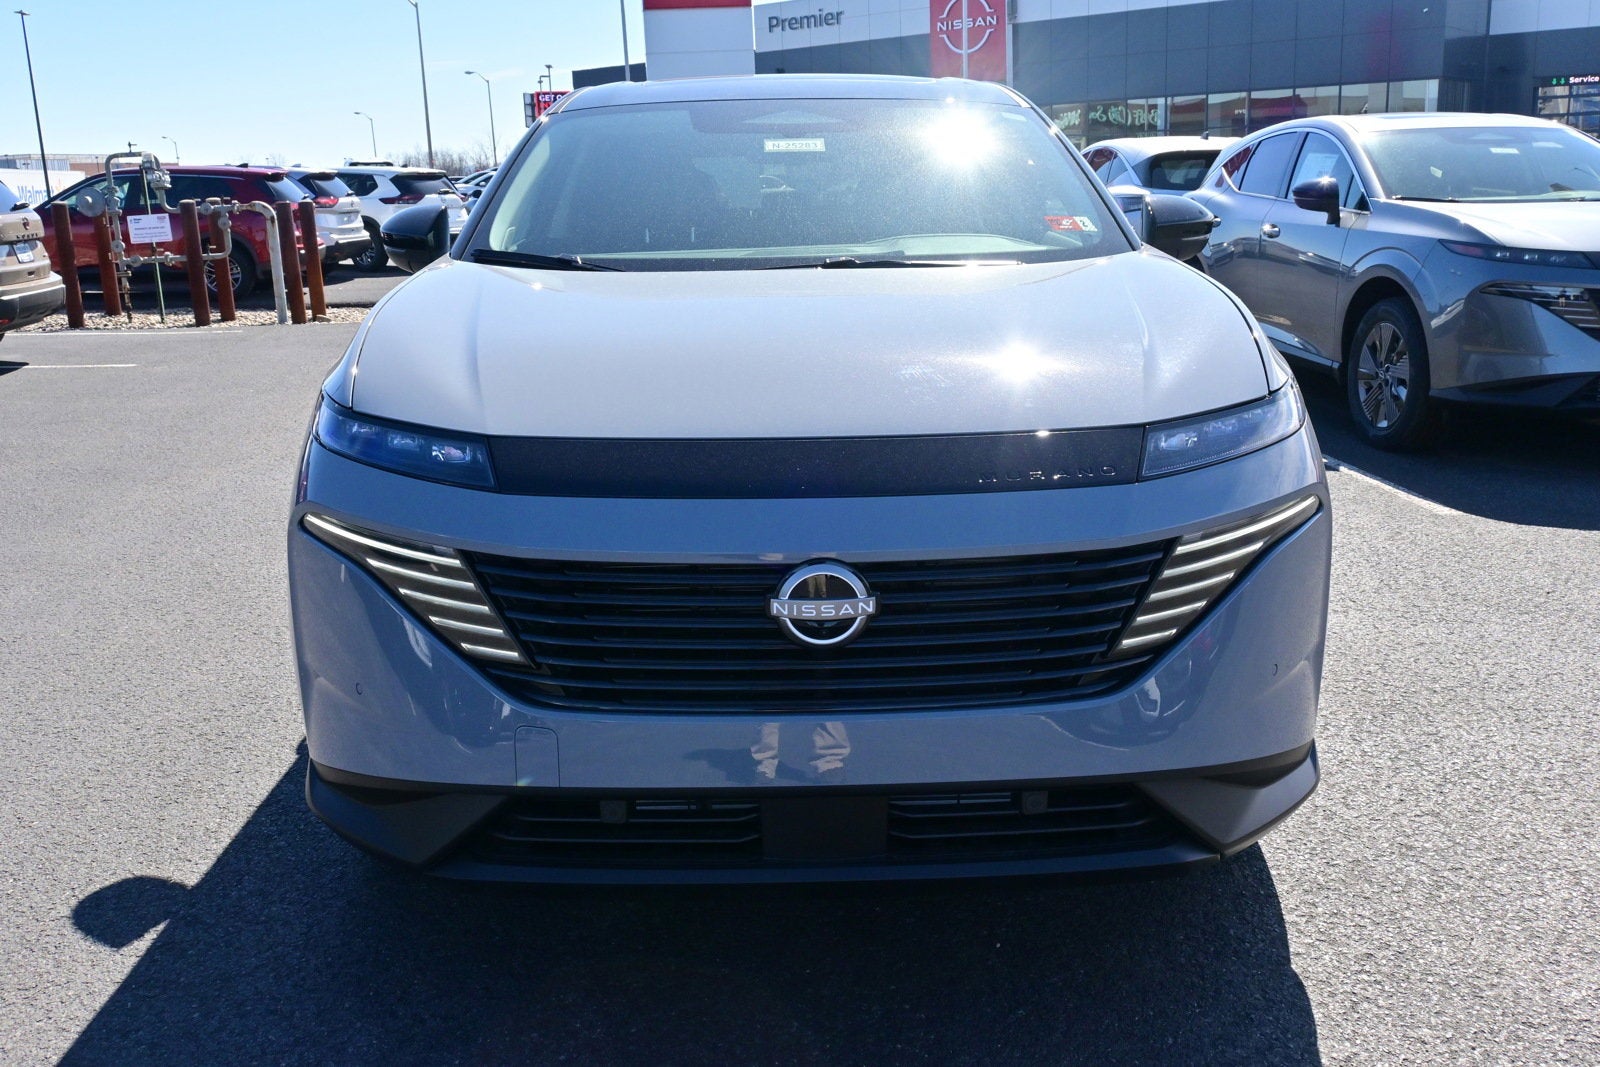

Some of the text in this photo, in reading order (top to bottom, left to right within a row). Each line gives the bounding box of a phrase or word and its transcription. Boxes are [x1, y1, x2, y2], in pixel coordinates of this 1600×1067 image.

[768, 8, 844, 33] Premier
[937, 15, 997, 32] NISSAN
[1569, 75, 1600, 84] Service
[539, 94, 555, 102] GET
[17, 185, 55, 204] Walmat
[978, 466, 1117, 483] MURANO
[773, 600, 874, 617] NISSAN
